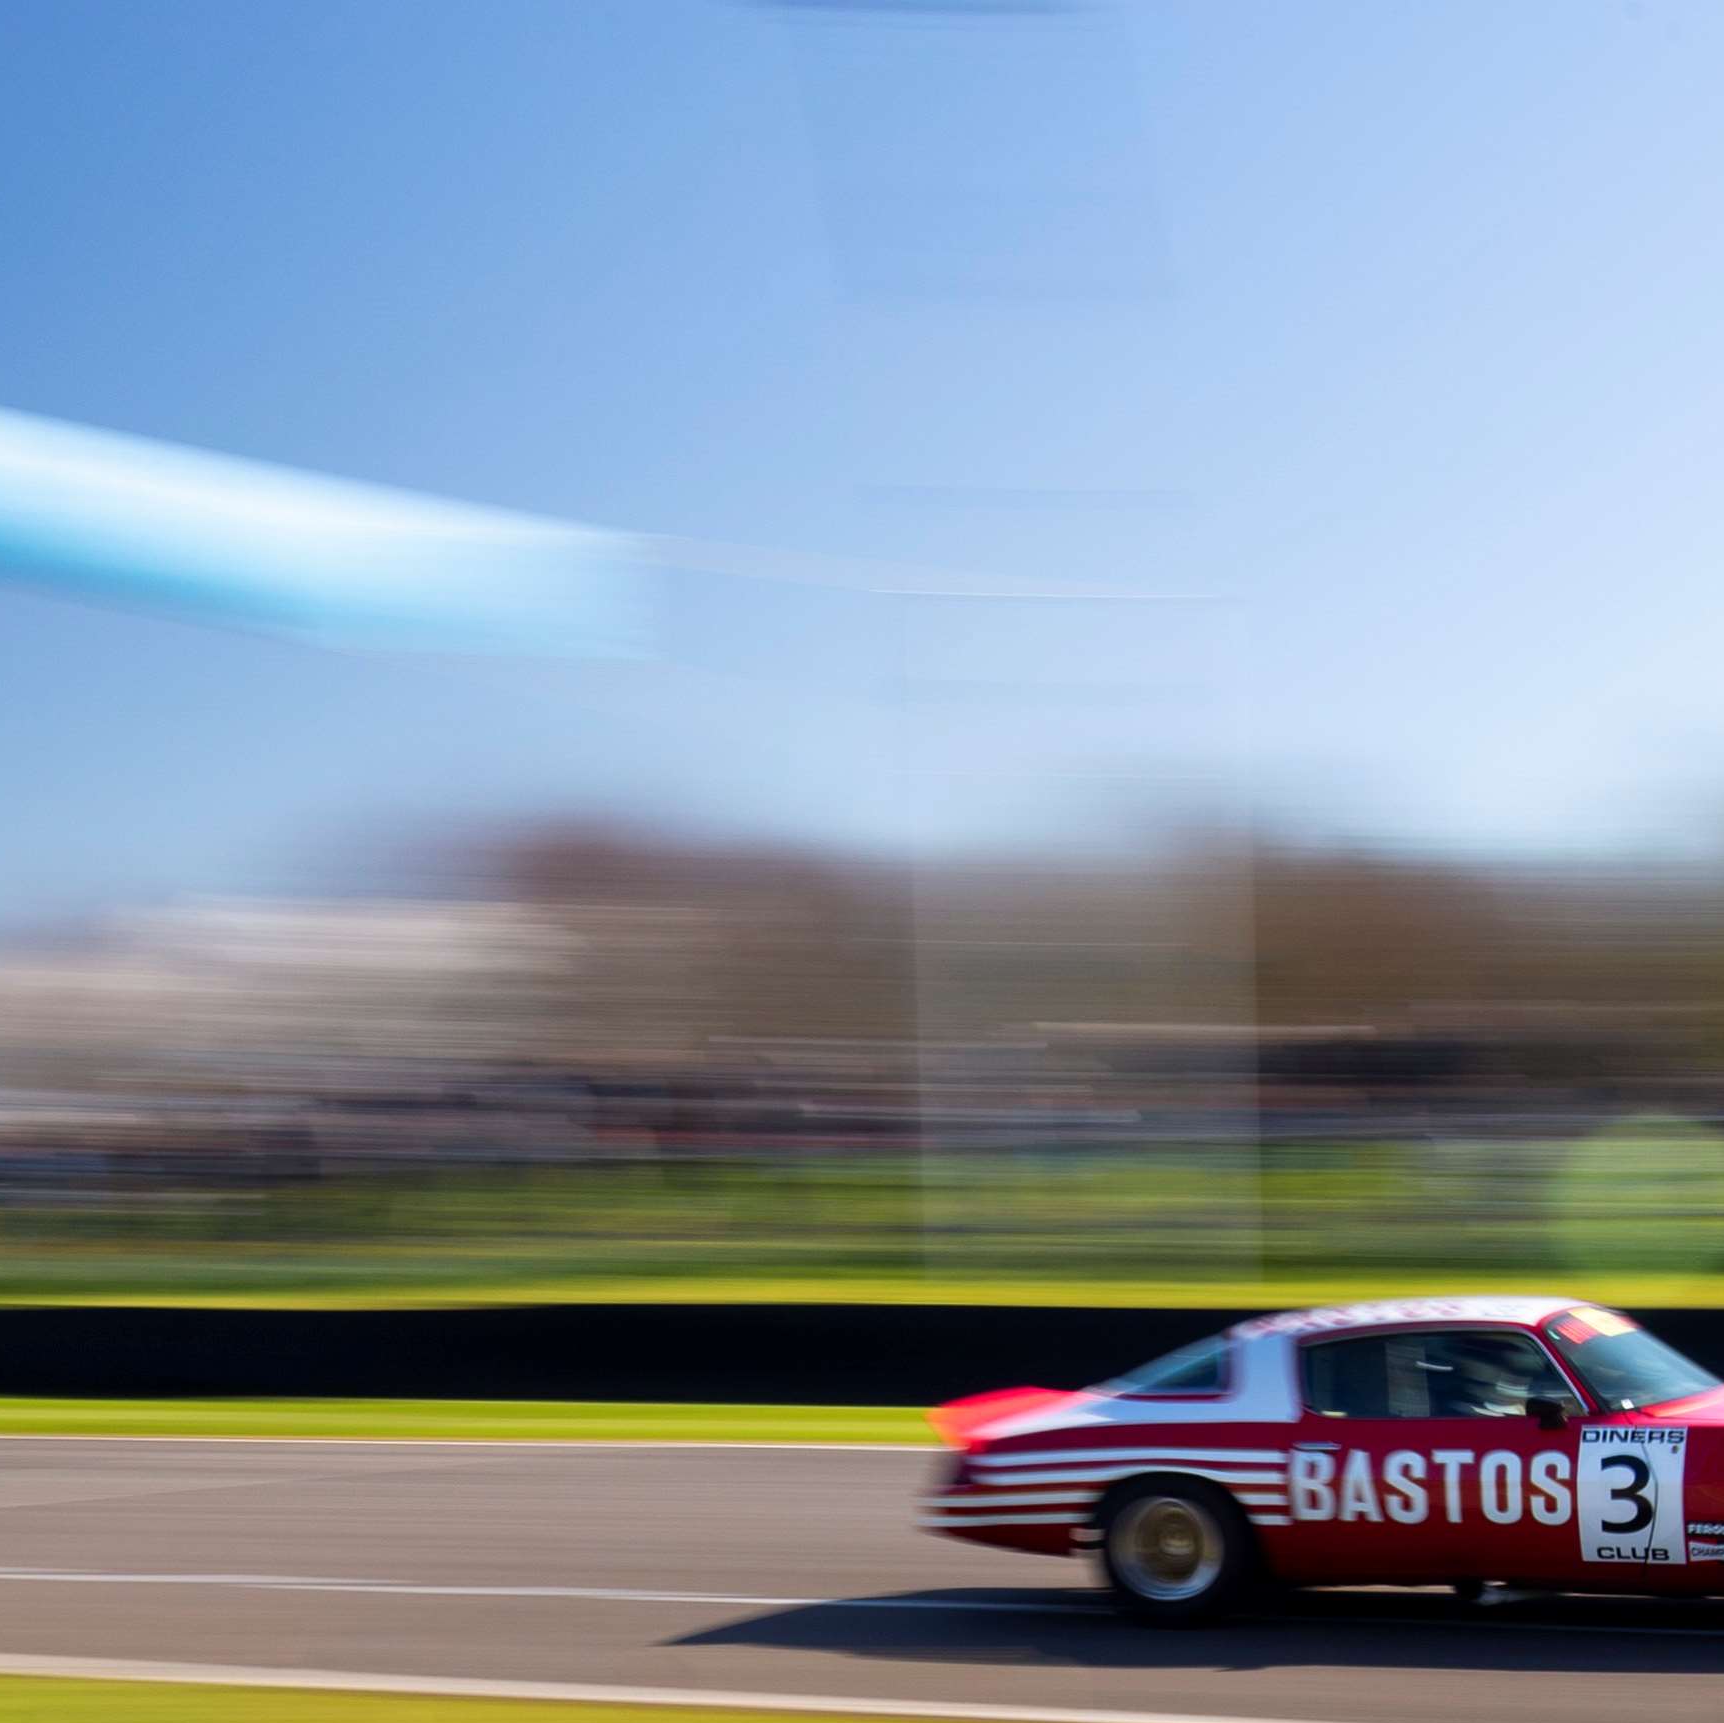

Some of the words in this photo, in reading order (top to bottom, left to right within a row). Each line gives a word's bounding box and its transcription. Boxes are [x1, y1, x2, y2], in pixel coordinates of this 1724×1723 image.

[1581, 1429, 1685, 1445] DINERS
[1288, 1448, 1573, 1527] BASTOS
[1600, 1454, 1654, 1535] 3
[1596, 1546, 1670, 1561] CLUB
